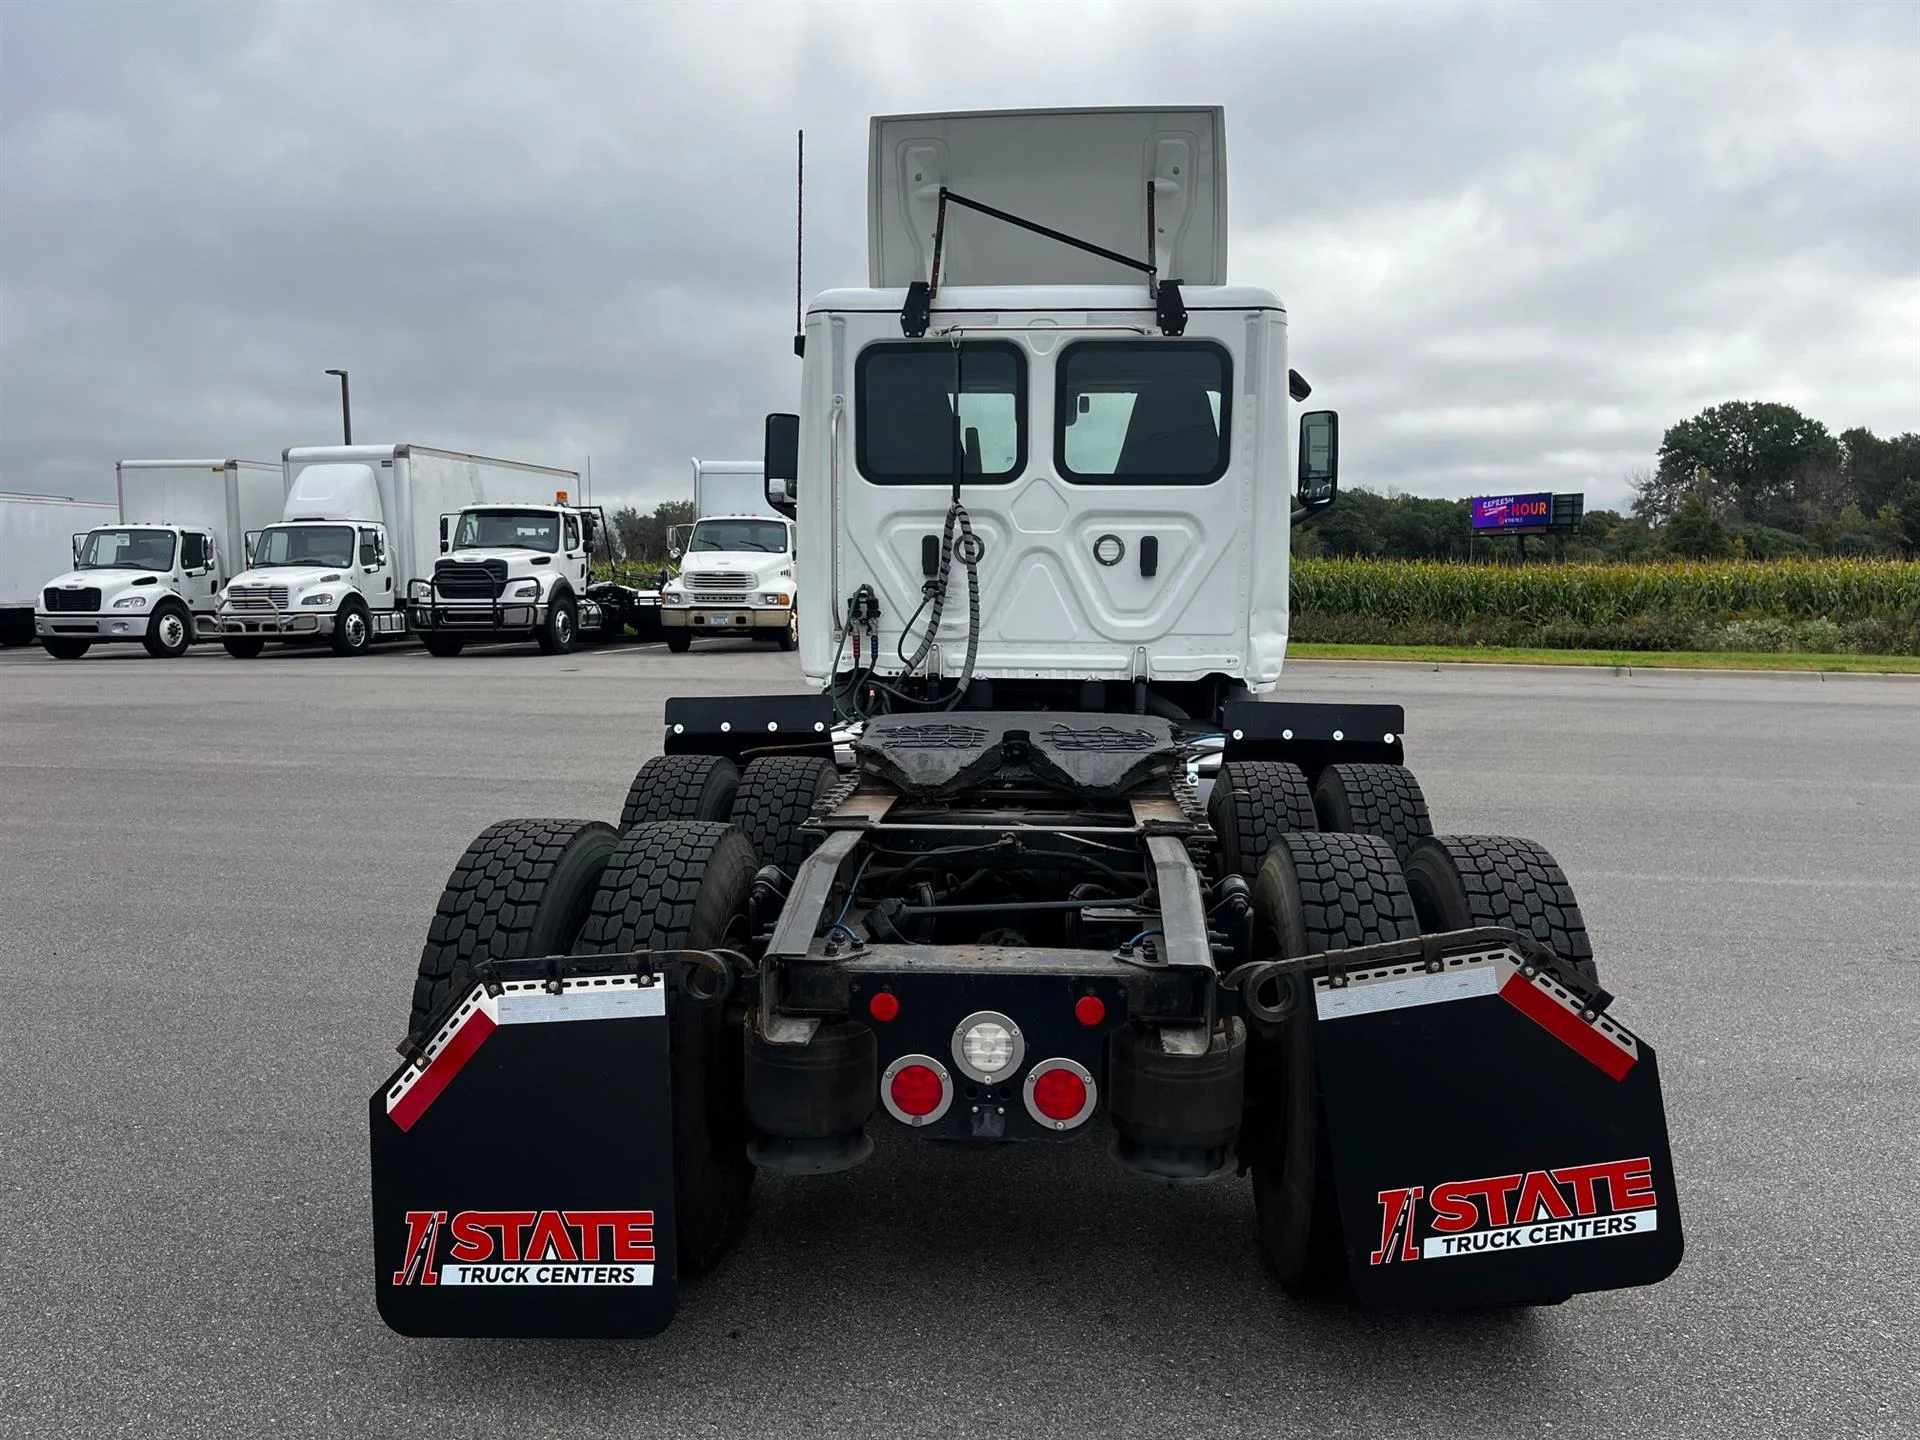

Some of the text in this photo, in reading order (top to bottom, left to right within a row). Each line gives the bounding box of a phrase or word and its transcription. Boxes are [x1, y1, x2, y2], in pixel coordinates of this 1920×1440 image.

[1511, 502, 1546, 516] HOUR
[1429, 1156, 1657, 1232] STATE
[450, 1211, 655, 1262] STATE
[1442, 1215, 1637, 1254] TRUCK CENTERS
[458, 1267, 635, 1283] TRUCK CENTERS
